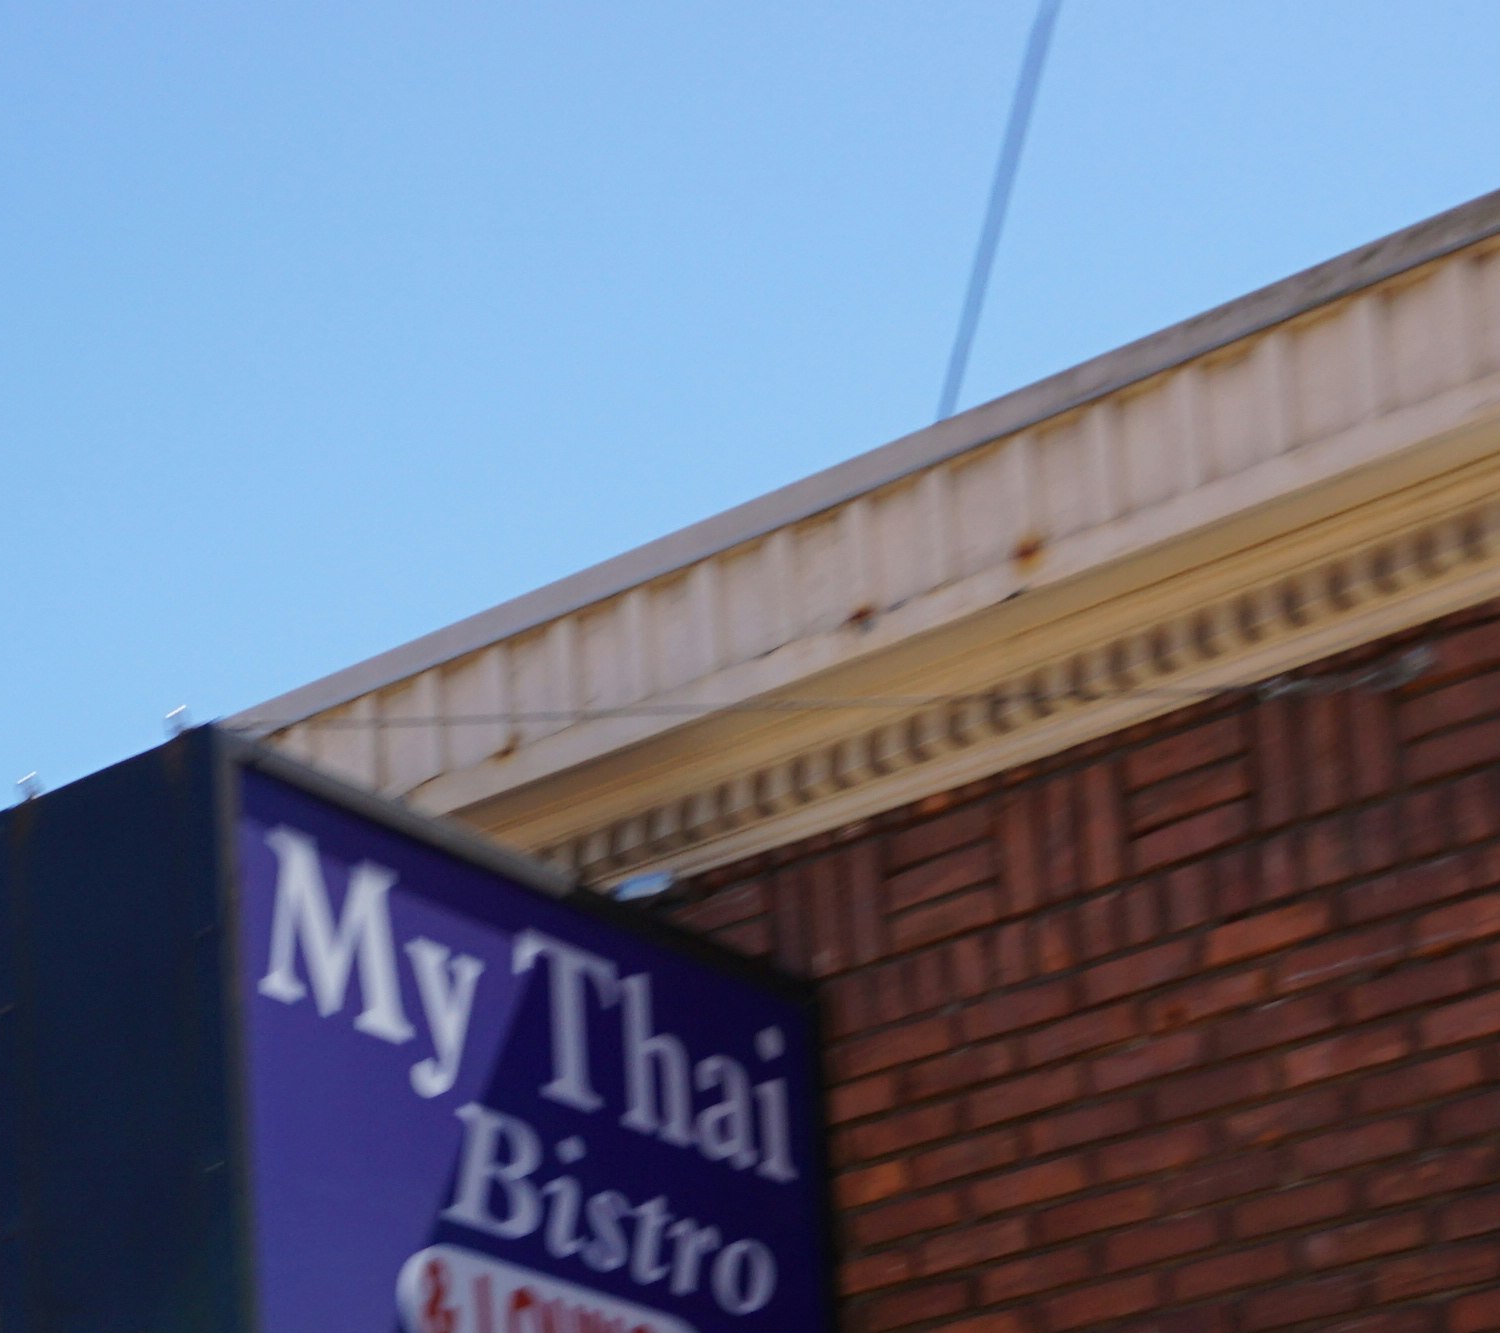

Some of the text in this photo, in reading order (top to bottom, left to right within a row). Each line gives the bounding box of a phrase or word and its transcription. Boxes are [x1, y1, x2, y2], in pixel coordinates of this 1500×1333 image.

[258, 825, 799, 1183] My Thai
[443, 1102, 779, 1314] Bistro
